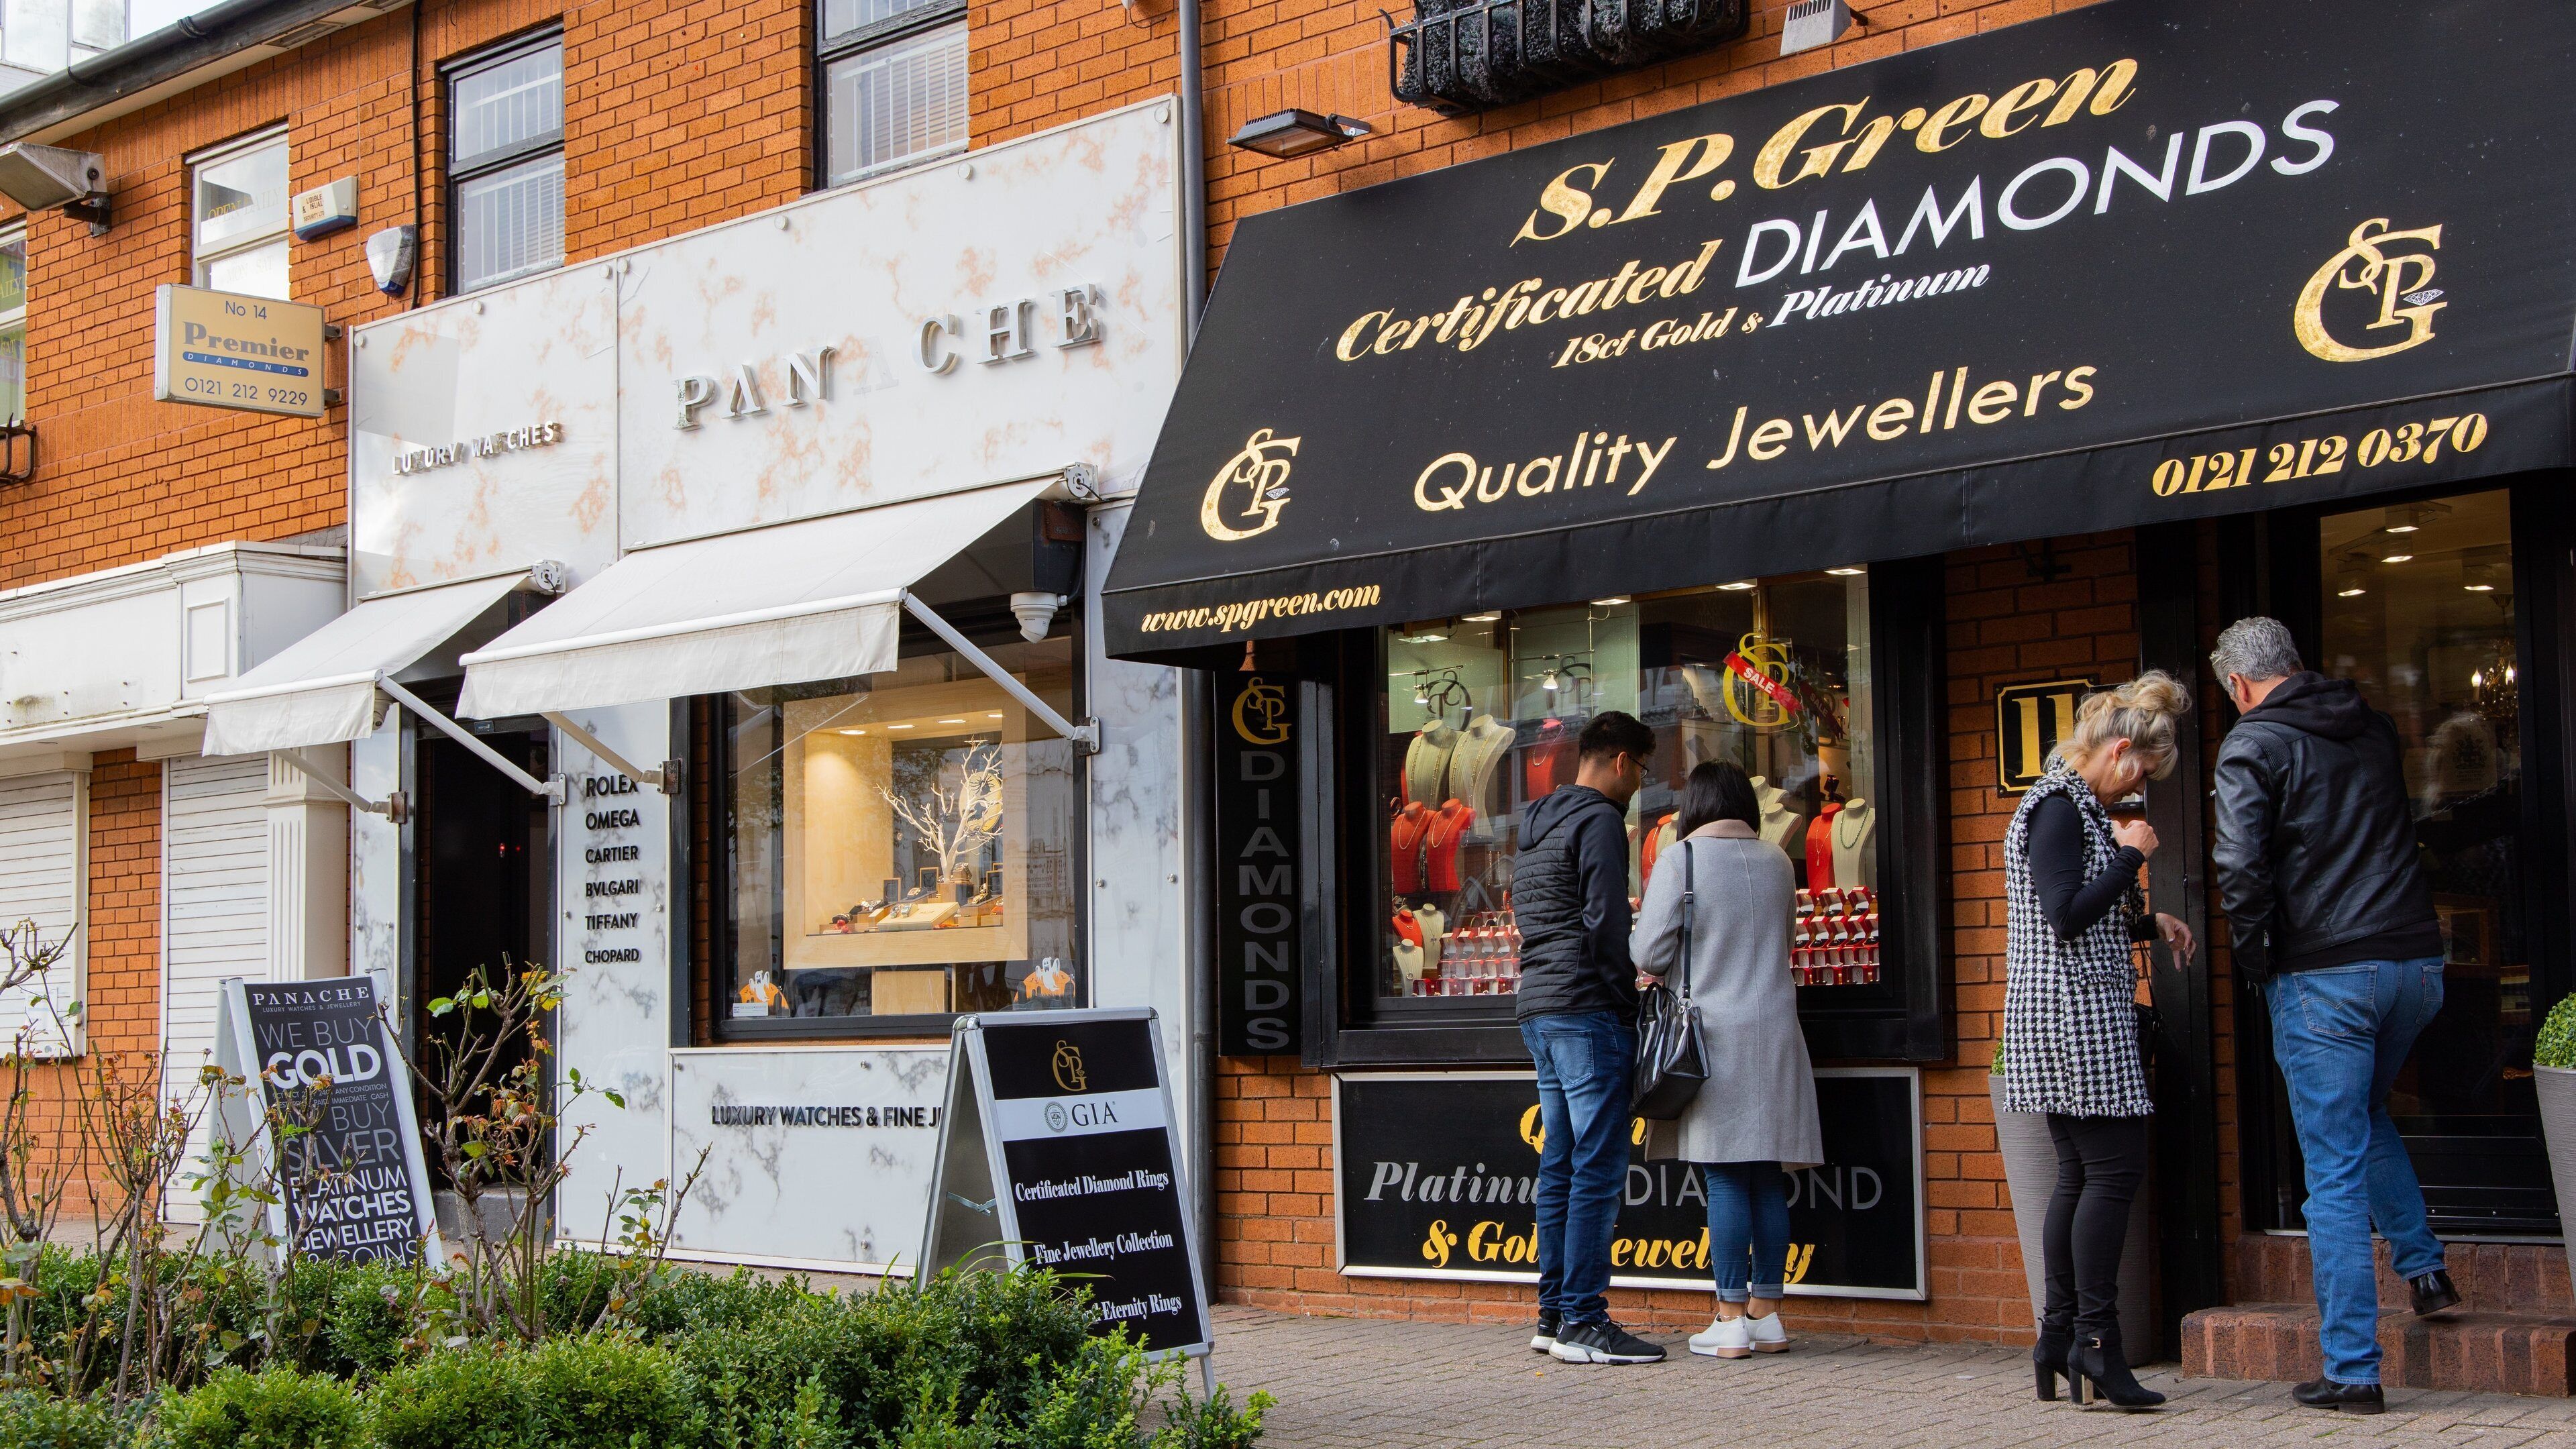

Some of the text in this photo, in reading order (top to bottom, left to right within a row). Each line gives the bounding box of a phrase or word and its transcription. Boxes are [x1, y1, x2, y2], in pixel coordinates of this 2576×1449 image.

[1752, 58, 2139, 199] Green
[207, 200, 242, 227] OPEN
[1336, 99, 2341, 362] Certificated DIAMONDS
[225, 300, 268, 320] No 14
[1551, 262, 1991, 369] 18ct Gold & Platinum
[182, 321, 310, 362] Premier
[187, 353, 303, 376] DIAMONDS
[184, 377, 307, 407] 0121 212 9229
[1414, 365, 2098, 513] Quality Jewellers
[2151, 412, 2489, 498] 0121 212 0370
[1140, 584, 1381, 634] www.spgreen.com
[1743, 667, 1775, 694] SALE
[2012, 693, 2074, 778] 11
[586, 774, 639, 798] ROLEX
[585, 808, 640, 830] OMEGA
[585, 845, 639, 863] CARTIER
[586, 879, 639, 898] BVLGARI
[1238, 750, 1292, 1050] DIAMONDS
[585, 912, 639, 930] TIFFANY
[585, 948, 640, 965] CHOPARD
[252, 986, 370, 1006] PANACHE
[327, 1001, 361, 1010] JEWELLERY
[258, 1018, 372, 1049] WE BUY
[268, 1044, 381, 1089] GOLD
[332, 1095, 367, 1104] IMMEDIATE
[370, 1091, 389, 1100] CASH
[350, 1083, 387, 1093] CONDITION
[331, 1100, 390, 1132] BUY
[712, 1106, 775, 1126] LUXURY
[780, 1106, 861, 1126] WATCHES
[866, 1106, 878, 1127] &
[883, 1106, 926, 1127] FINE
[1071, 1101, 1120, 1127] GIA
[283, 1128, 400, 1172] SILVER
[1015, 1169, 1169, 1201] Certificated Diamond Rings
[1364, 1161, 1540, 1203] Platinu
[293, 1189, 411, 1224] WATCHES
[1033, 1230, 1174, 1265] Fine Jewellery Collection
[1422, 1219, 1457, 1268] &
[1468, 1220, 1539, 1265] Gol
[1101, 1297, 1148, 1322] Eternity
[1148, 1293, 1182, 1316] Rings
